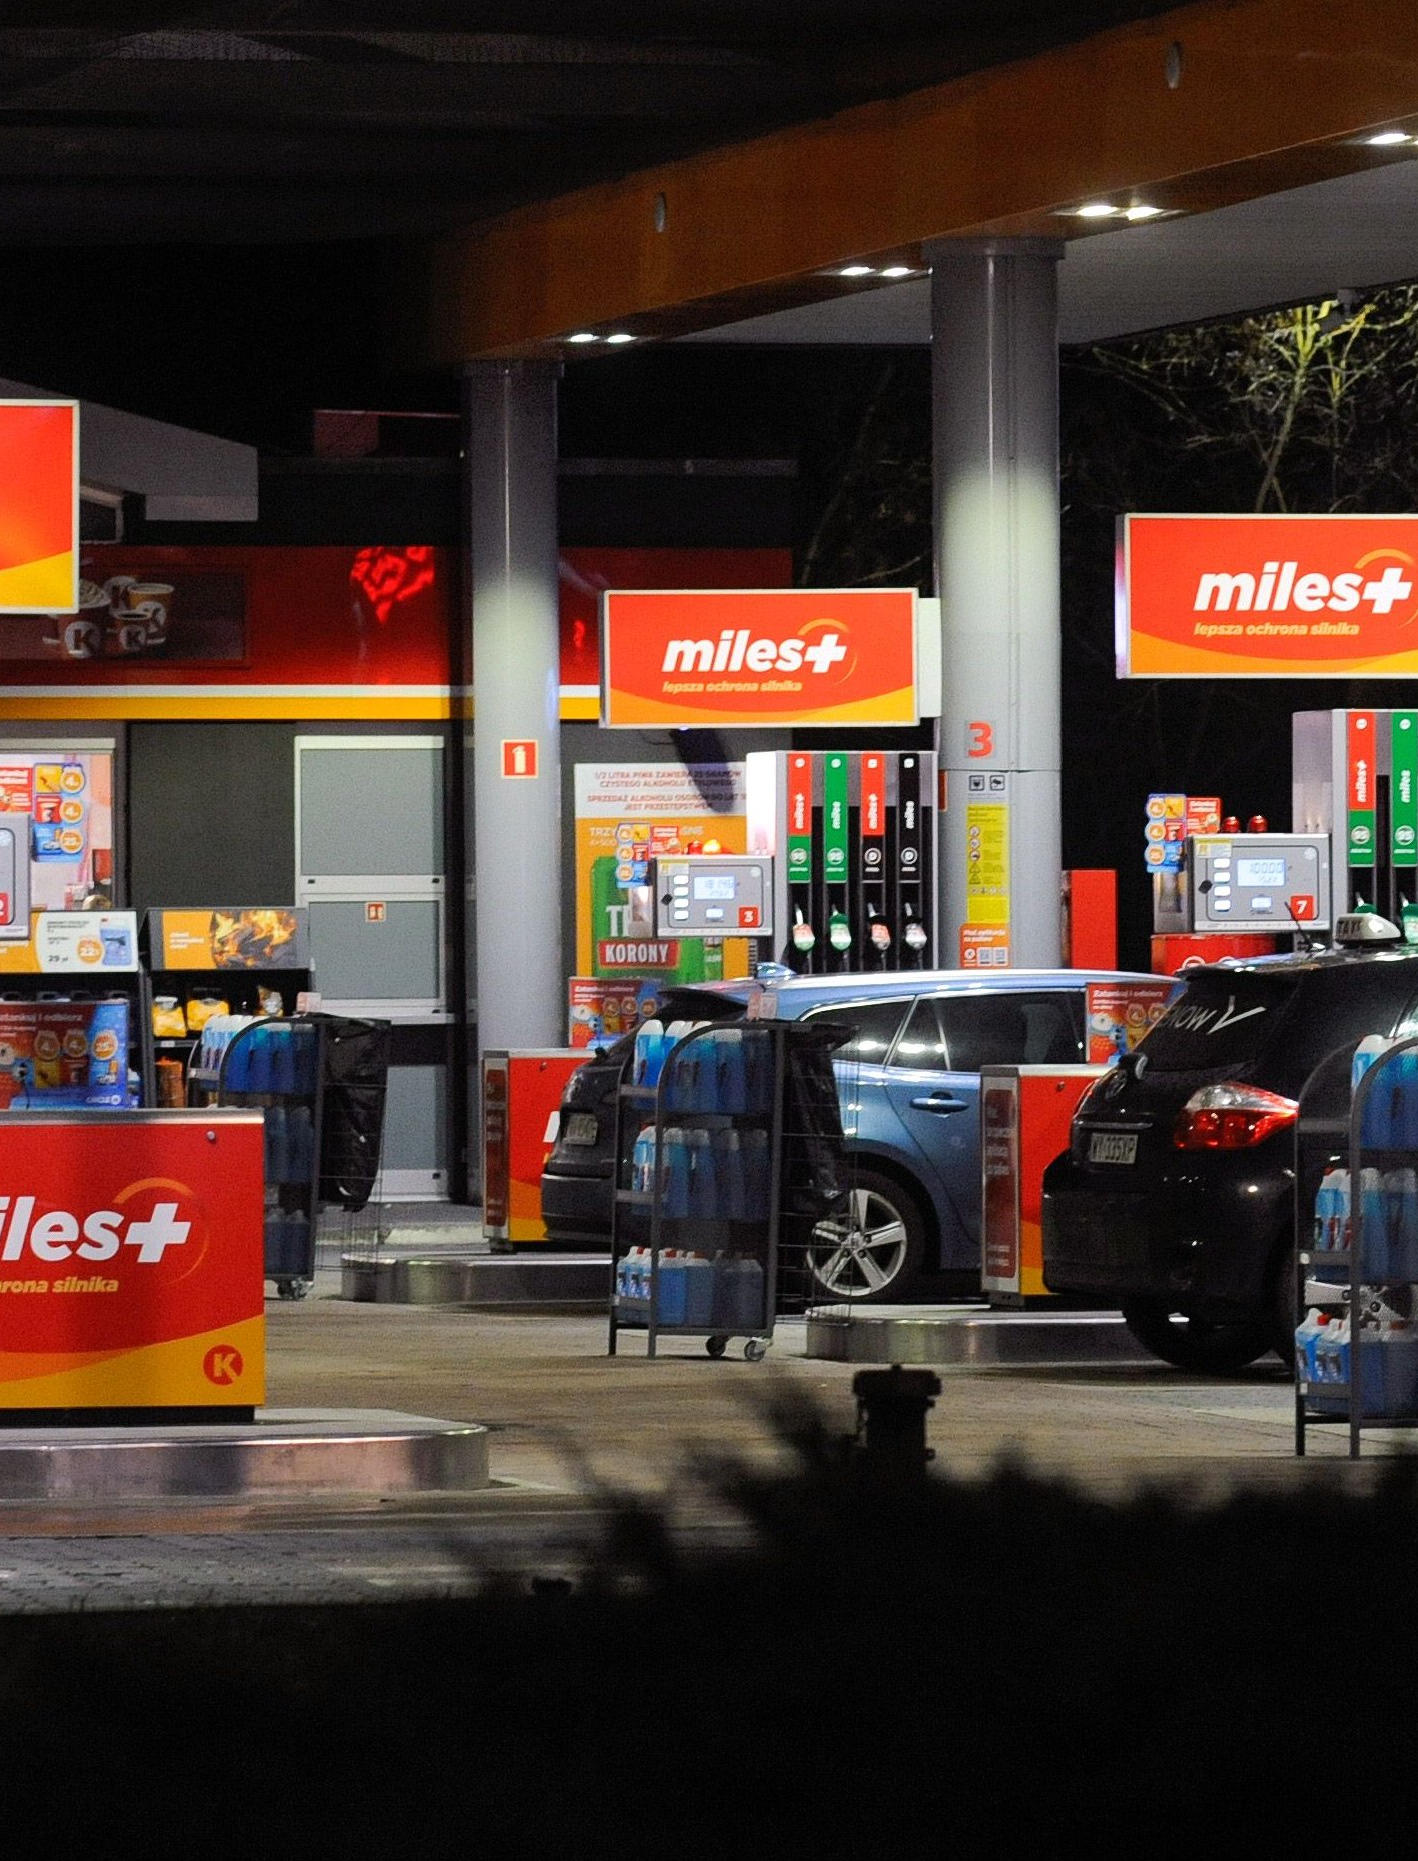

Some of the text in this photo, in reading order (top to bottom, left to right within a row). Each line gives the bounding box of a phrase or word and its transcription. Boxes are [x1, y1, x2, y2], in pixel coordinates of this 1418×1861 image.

[1193, 561, 1413, 614] miles+
[1194, 621, 1360, 638] lepsza ochrona silnika
[662, 629, 847, 674] miles+
[662, 680, 802, 695] lepsza ochrona silnika
[967, 722, 994, 757] 3
[1296, 900, 1308, 914] 7
[744, 911, 754, 923] 3
[605, 944, 669, 963] KORONY
[52, 1276, 119, 1293] silnika
